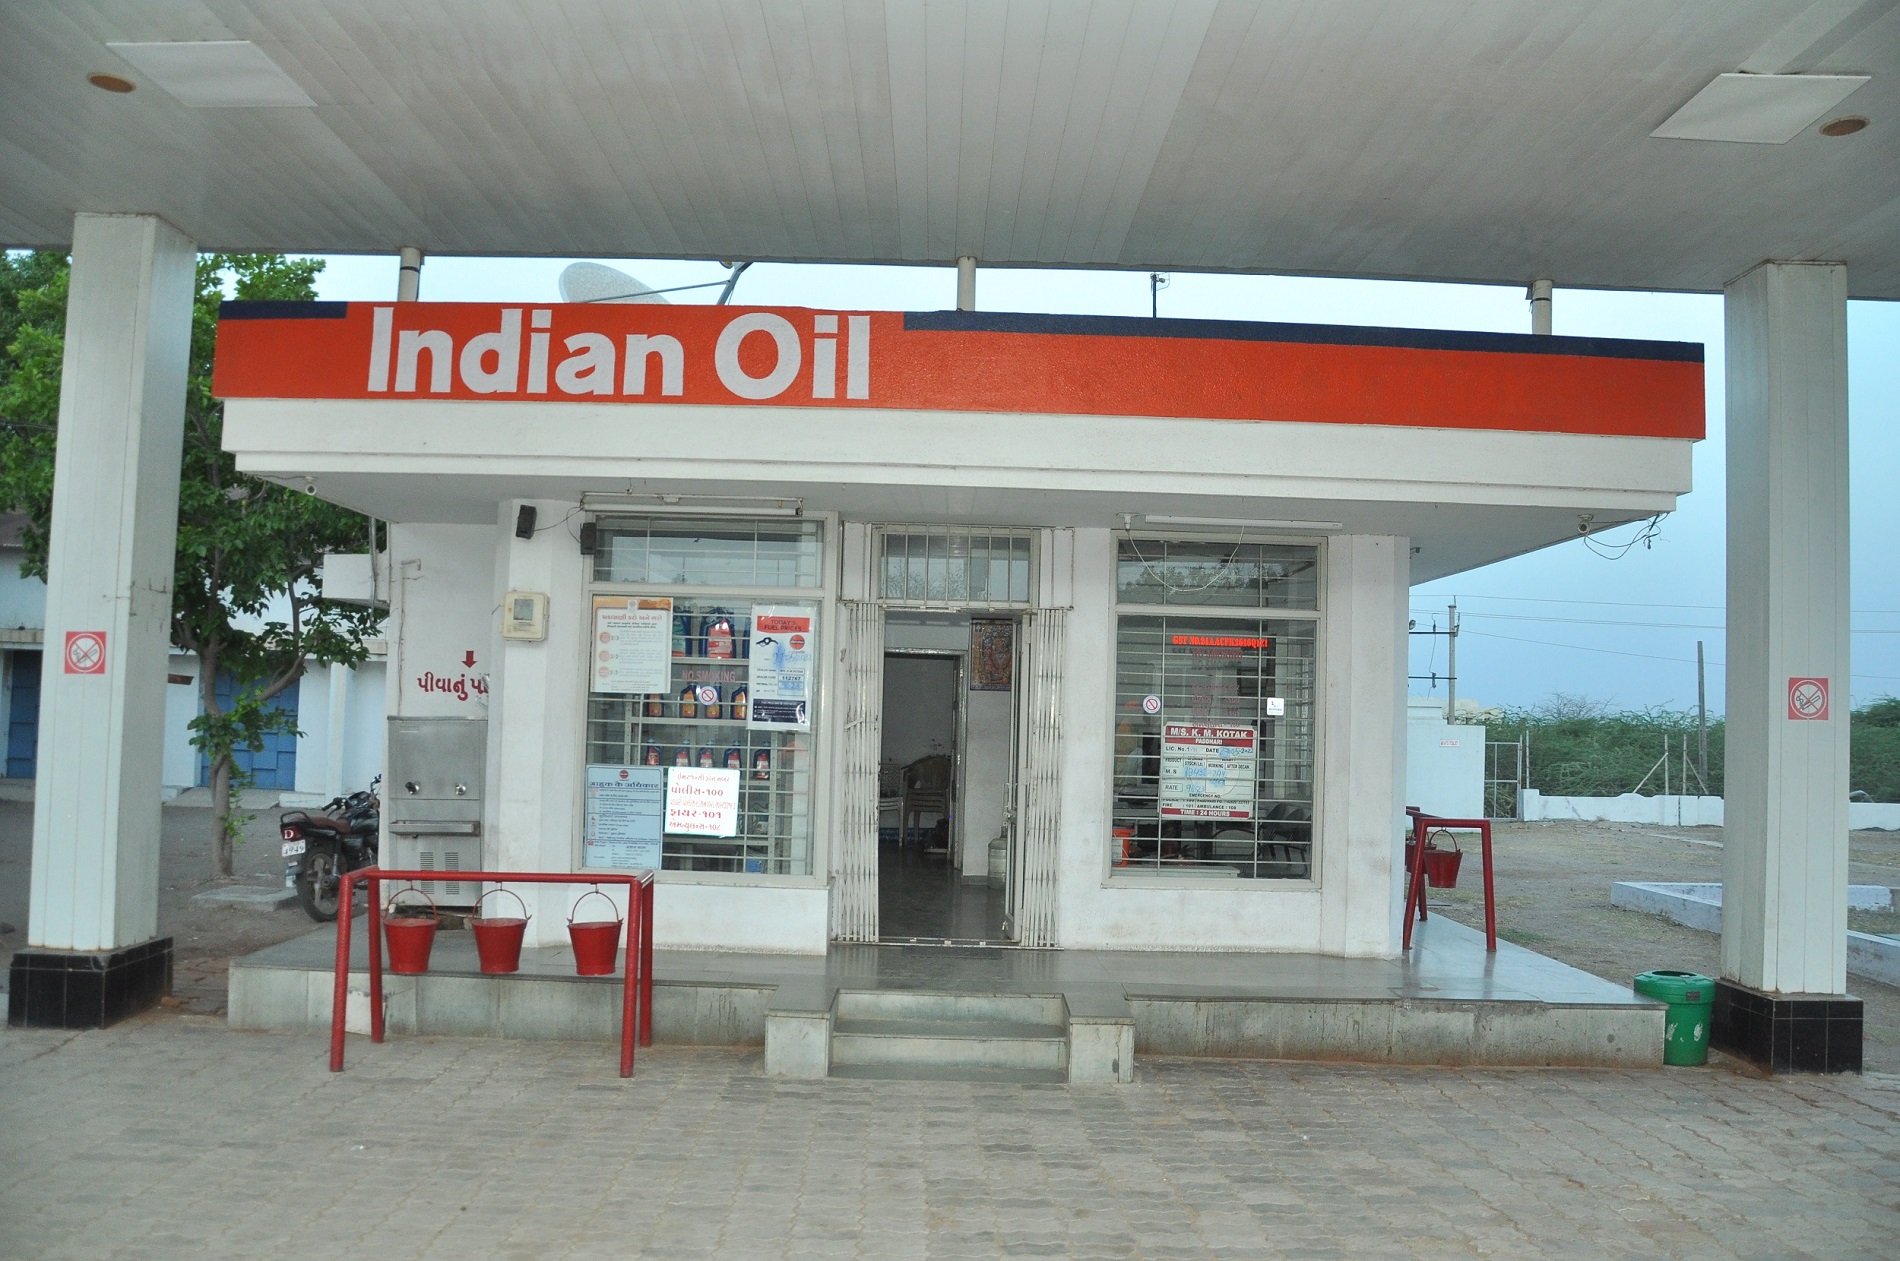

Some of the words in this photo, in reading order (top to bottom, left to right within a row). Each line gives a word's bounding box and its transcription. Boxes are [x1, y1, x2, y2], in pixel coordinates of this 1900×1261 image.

[367, 307, 684, 397] Indian
[715, 312, 870, 400] Oil
[1172, 635, 1188, 645] GST
[682, 670, 694, 681] NO
[697, 670, 736, 683] SMOKING
[417, 671, 468, 701] પીવાનું
[1170, 727, 1189, 736] M/S.
[1191, 728, 1200, 737] K.
[1203, 729, 1214, 737] M.
[1216, 730, 1248, 738] KOTAK
[284, 829, 294, 839] D
[283, 845, 304, 855] 4949
